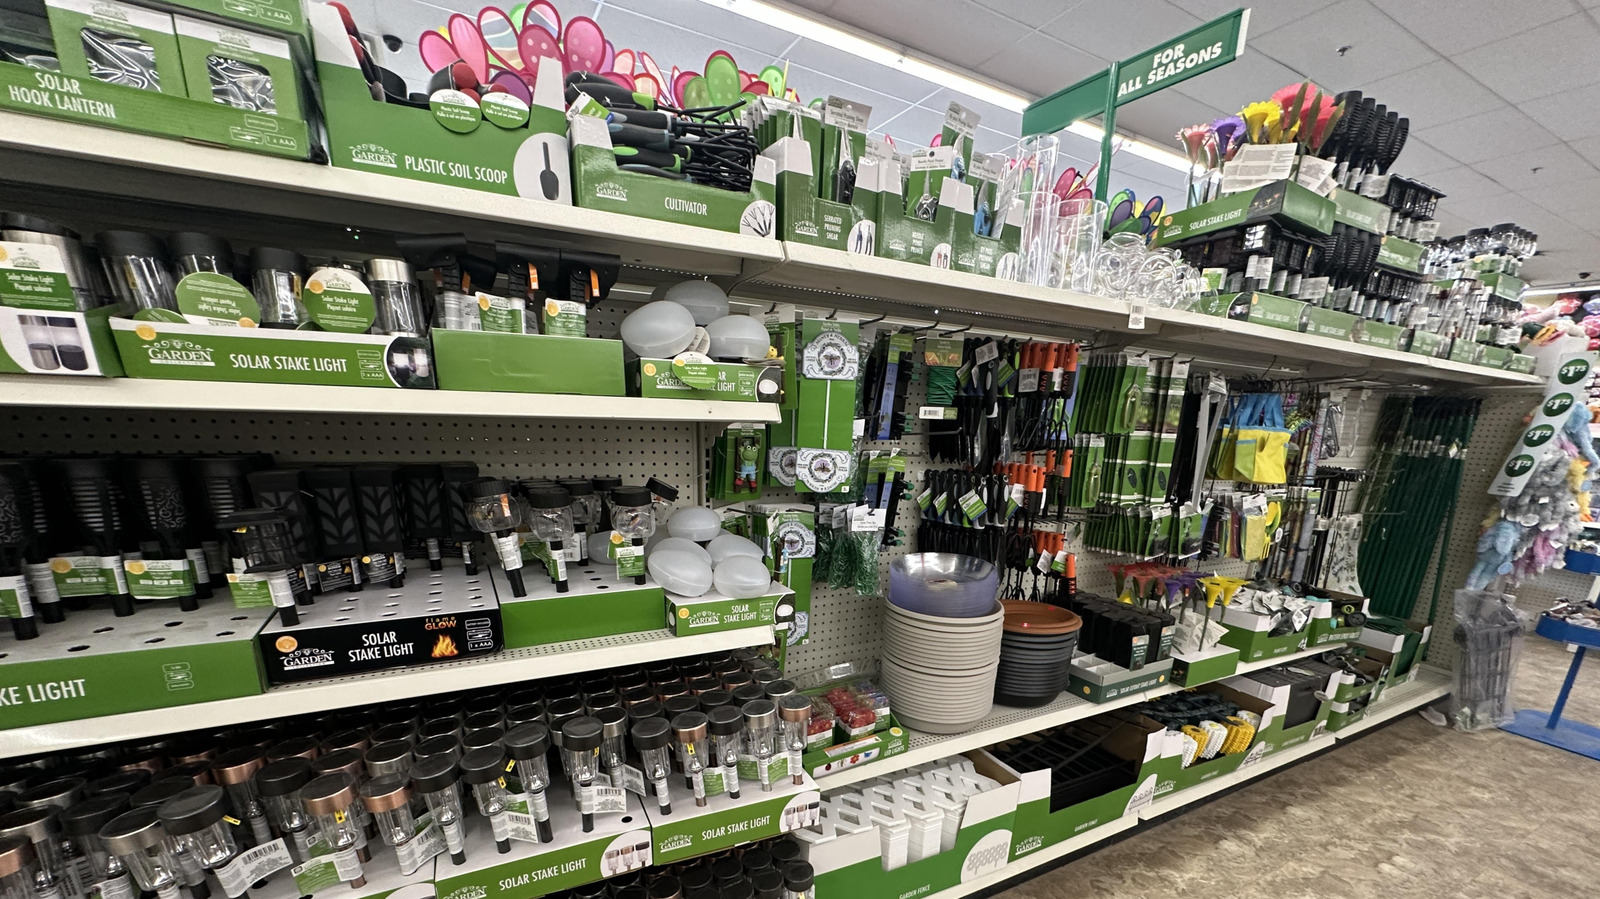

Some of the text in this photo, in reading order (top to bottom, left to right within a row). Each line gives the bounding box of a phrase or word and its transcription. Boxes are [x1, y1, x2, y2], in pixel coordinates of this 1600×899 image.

[1152, 43, 1186, 68] FOR
[1118, 42, 1222, 98] ALL SEASONS
[35, 72, 82, 95] SOLAR
[8, 85, 116, 118] HOOK LANTERN
[352, 150, 395, 164] GARDEN
[404, 155, 508, 184] PLASTIC SOIL SCOOP
[596, 187, 627, 198] GARDEN
[664, 197, 707, 215] CULTIVATOR
[824, 214, 842, 224] SERRATED
[1190, 208, 1242, 230] SOLAR STAKE LIGHT
[824, 224, 841, 233] PRUNING
[826, 232, 838, 240] SHEAR
[347, 298, 359, 306] Light
[148, 348, 212, 361] GARDEN
[230, 353, 347, 373] SOLAR STAKE LIGHT
[718, 382, 735, 392] LIGHT
[732, 604, 749, 614] SOLAR
[425, 620, 457, 630] GLOW
[689, 616, 719, 625] GARDEN
[724, 612, 757, 624] STAKE LIGHT
[362, 631, 397, 647] SOLAR
[348, 642, 414, 662] STAKE LIGHT
[284, 654, 332, 668] GARDEN
[26, 678, 86, 703] LIGHT
[702, 816, 770, 840] SOLAR STAKE LIGHT
[661, 839, 691, 850] GARDEN
[1016, 839, 1042, 853] GARDEN
[499, 858, 586, 890] SOLAR STAKE LIGHT
[899, 884, 931, 899] GARDEN FENCE
